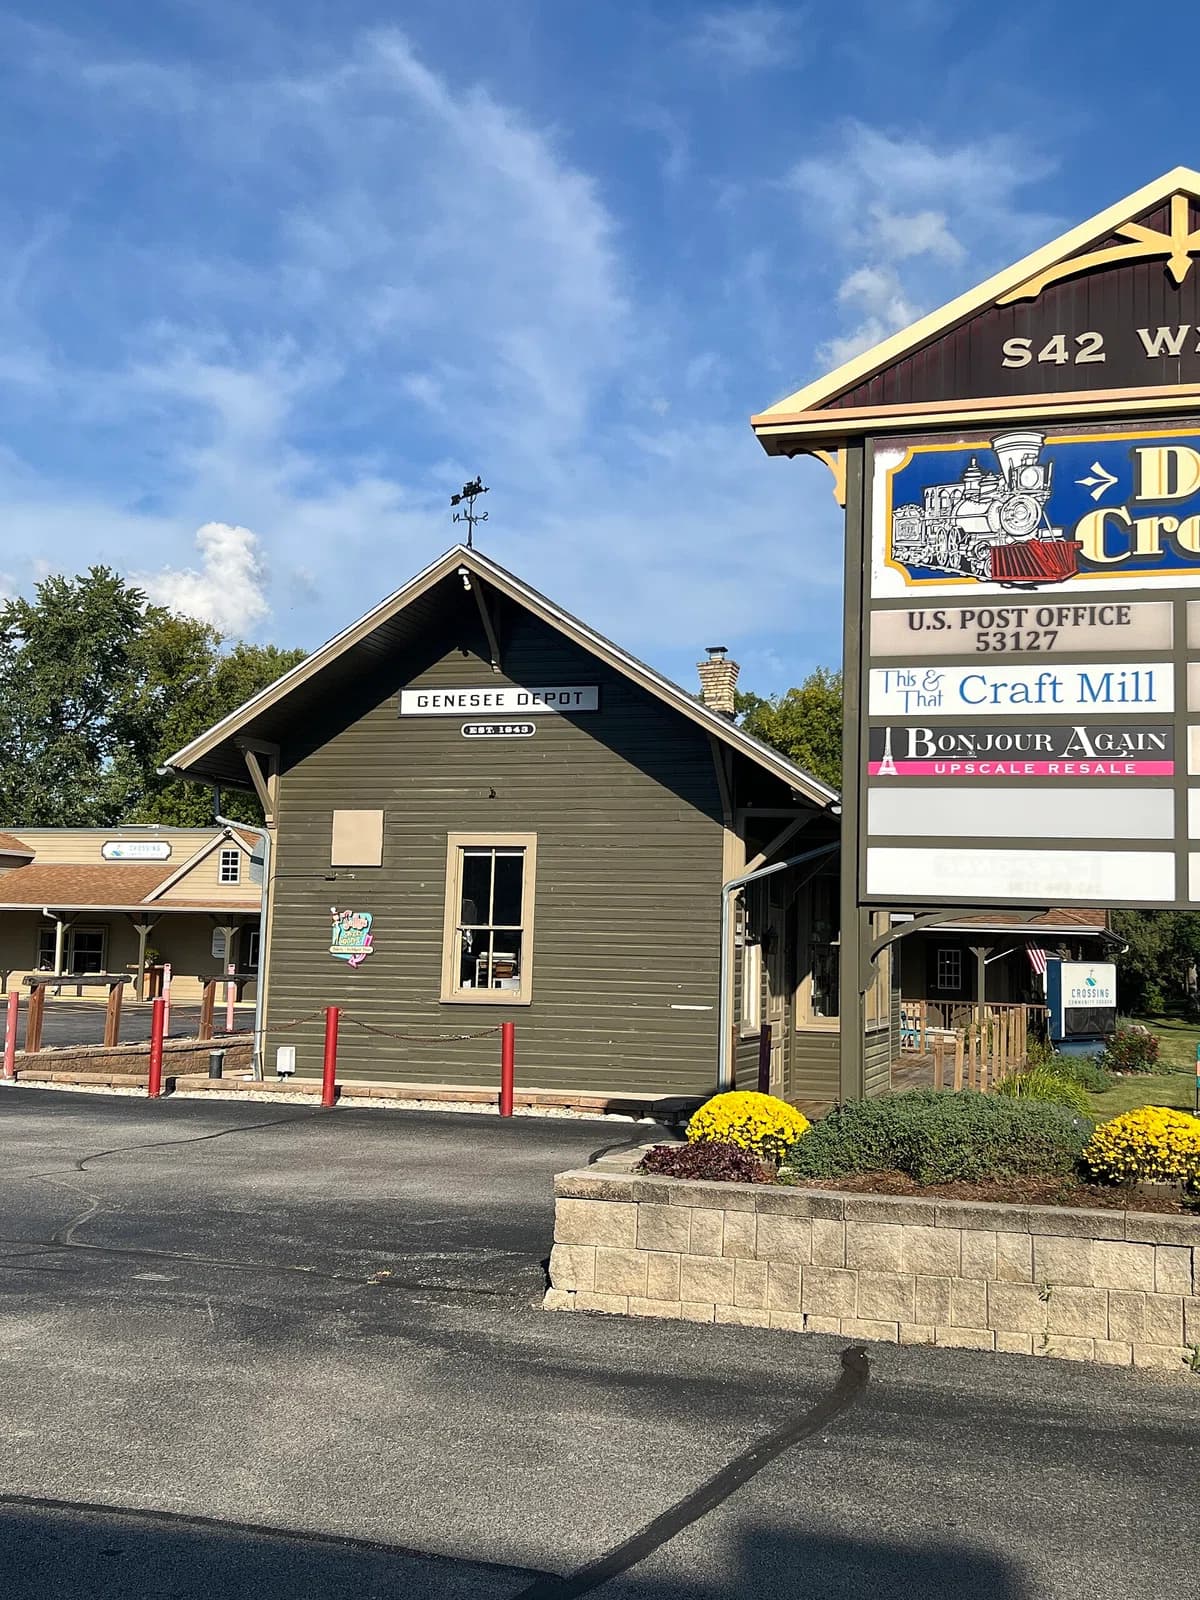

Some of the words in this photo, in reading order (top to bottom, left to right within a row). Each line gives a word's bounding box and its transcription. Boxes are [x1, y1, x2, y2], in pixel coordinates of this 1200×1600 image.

[1001, 332, 1106, 368] S42
[1137, 325, 1200, 358] W
[908, 611, 952, 630] U.S.
[960, 609, 1028, 629] POST
[1036, 606, 1131, 627] OFFICE
[976, 631, 1059, 651] 53127
[877, 670, 917, 693] This
[922, 669, 945, 691] &
[959, 673, 1064, 704] Craft
[1076, 671, 1157, 703] Mill
[417, 694, 504, 707] GENESEE
[518, 692, 583, 705] DEPOT
[896, 690, 944, 713] That
[904, 728, 1053, 759] BONJOUR
[1058, 726, 1167, 758] AGAIN
[934, 764, 1035, 774] UPSCALE
[1049, 764, 1136, 773] RESALE
[1072, 989, 1109, 998] CROSSING
